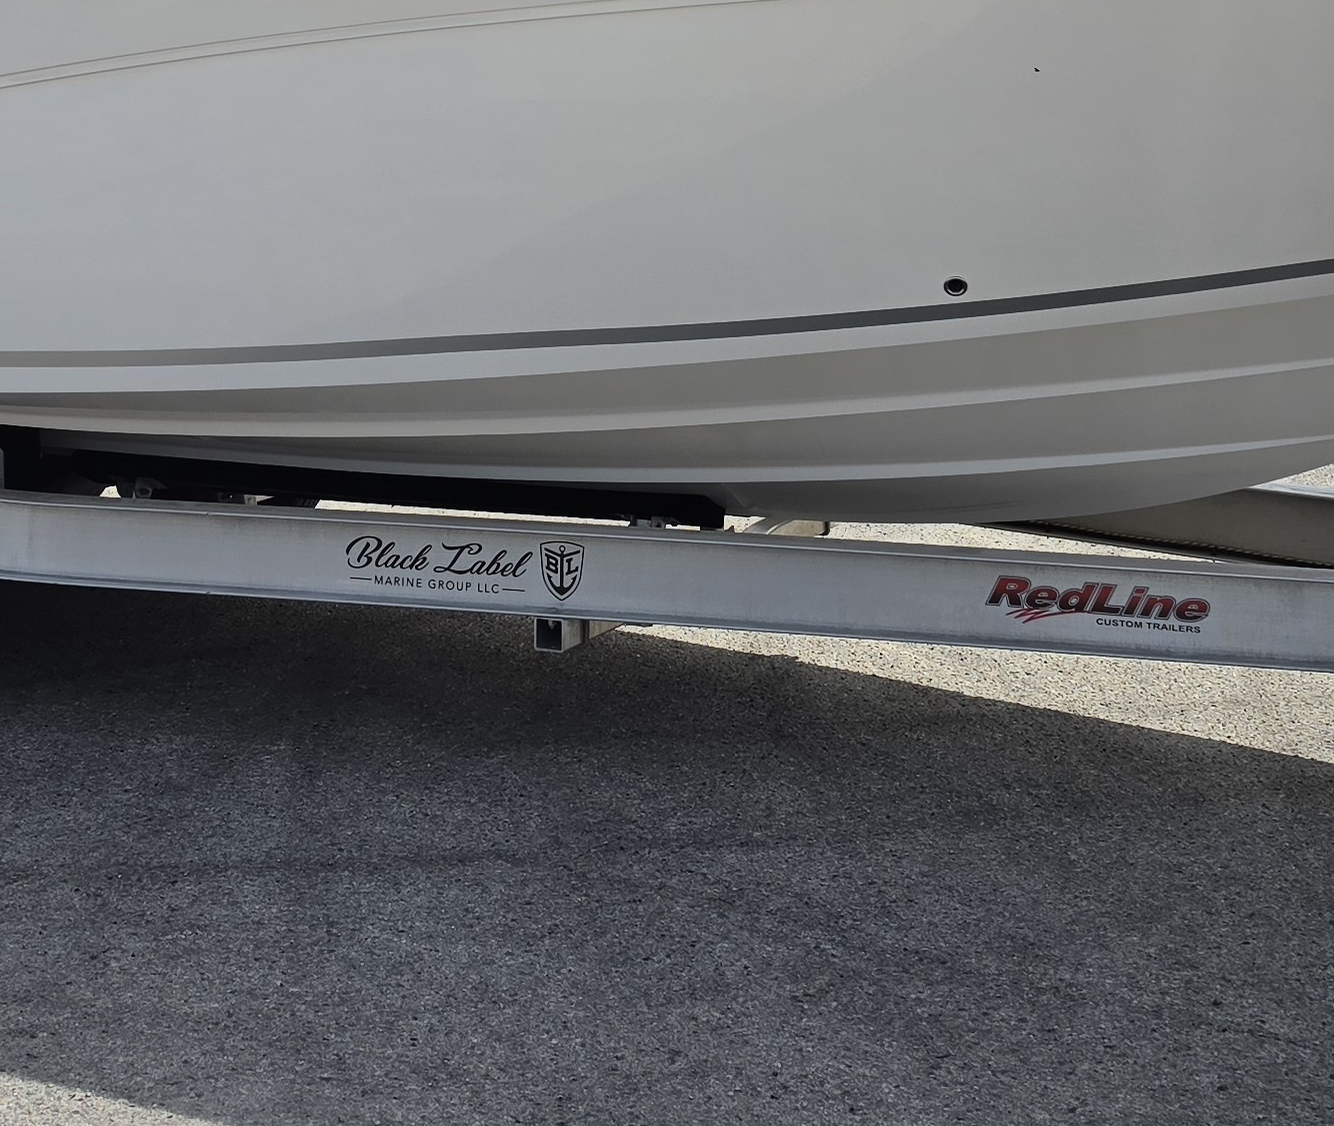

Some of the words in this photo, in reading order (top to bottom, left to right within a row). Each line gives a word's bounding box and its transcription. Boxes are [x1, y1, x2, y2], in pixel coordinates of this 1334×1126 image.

[345, 535, 433, 571] Black
[433, 541, 534, 578] Label
[373, 575, 422, 588] MARINE
[427, 579, 472, 592] GROUP
[477, 581, 500, 594] LLC
[985, 575, 1211, 622] RedLine
[1095, 618, 1143, 629] CUSTOM
[1147, 622, 1201, 634] TRAILERS
